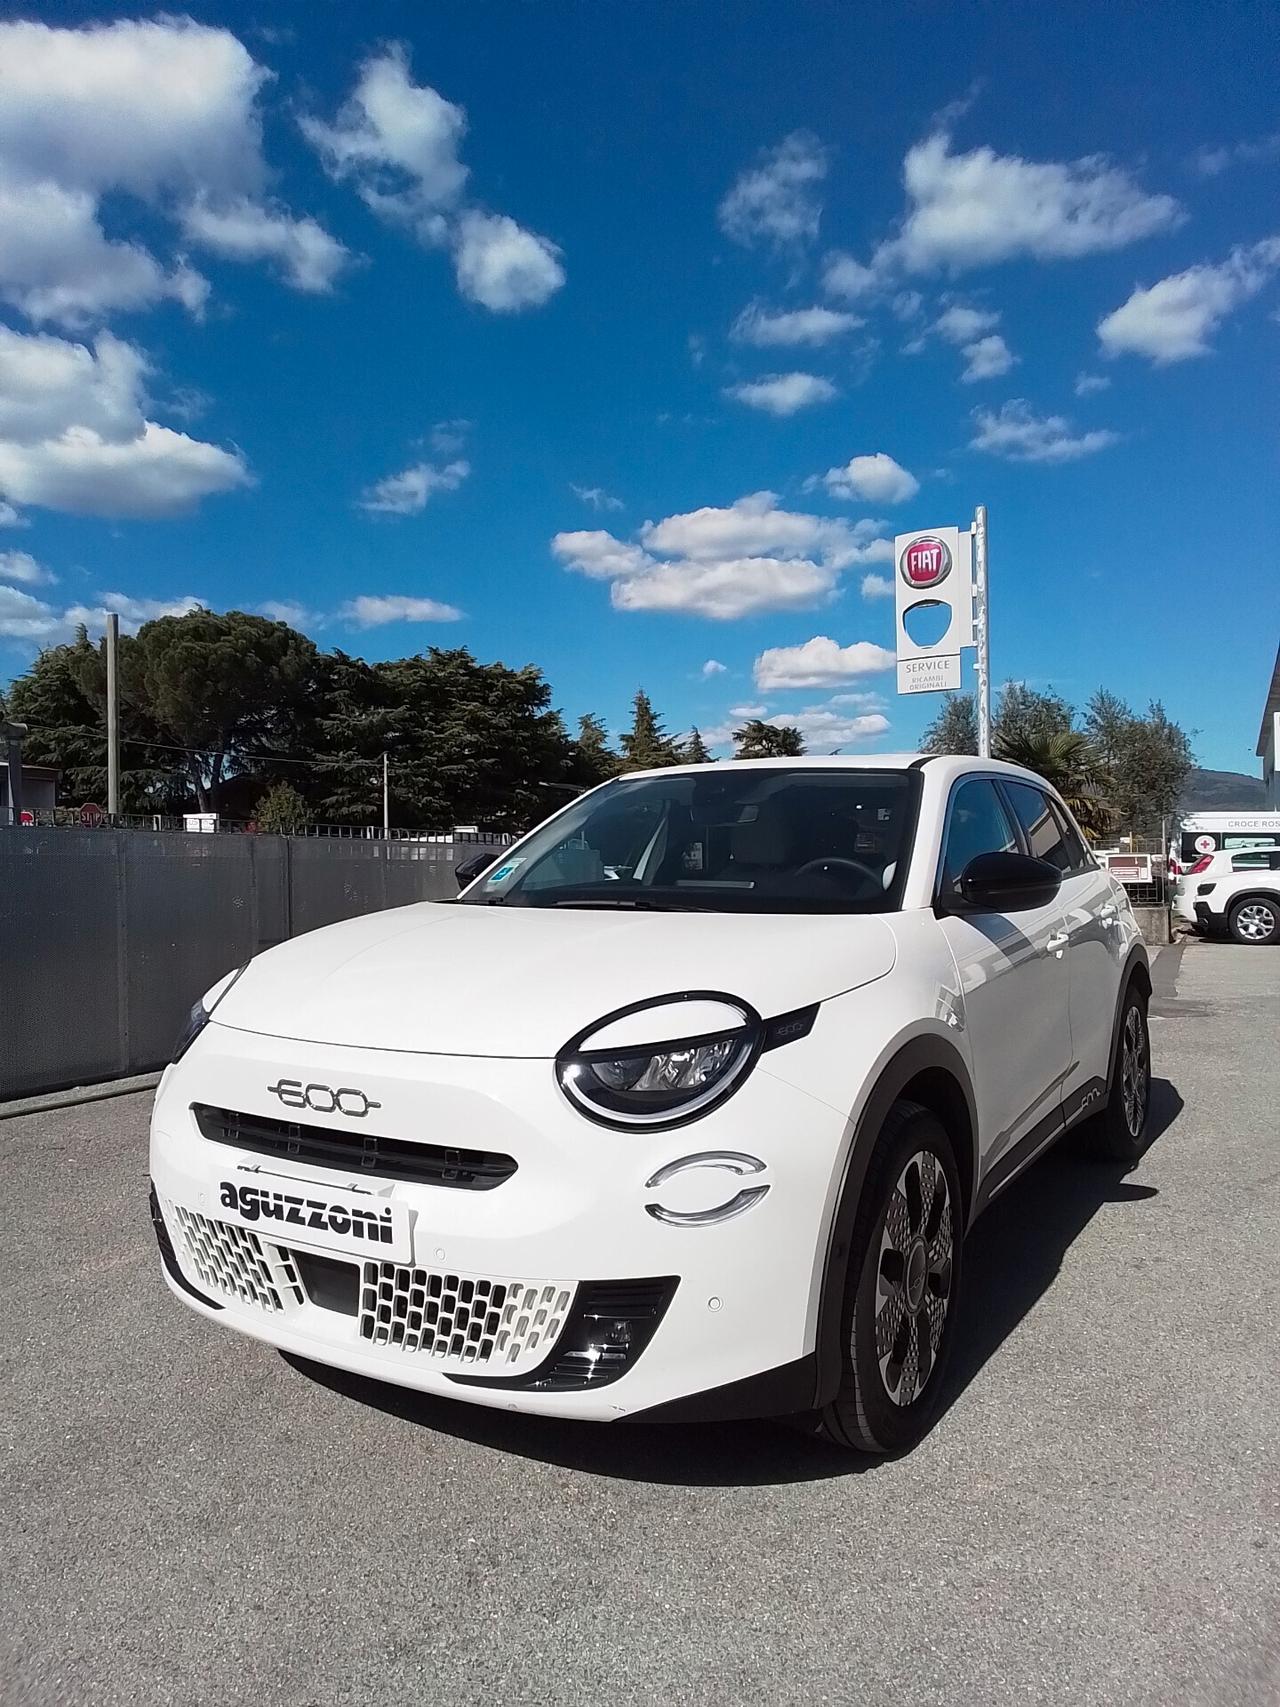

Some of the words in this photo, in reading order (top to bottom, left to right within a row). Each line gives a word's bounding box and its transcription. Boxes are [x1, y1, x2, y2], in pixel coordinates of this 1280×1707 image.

[911, 548, 939, 571] FIAT
[905, 660, 950, 673] SERVICE
[909, 681, 947, 691] ORIGINALI
[1228, 820, 1259, 828] CROCE
[270, 1078, 378, 1118] 600
[219, 1180, 394, 1245] aguzzoni
